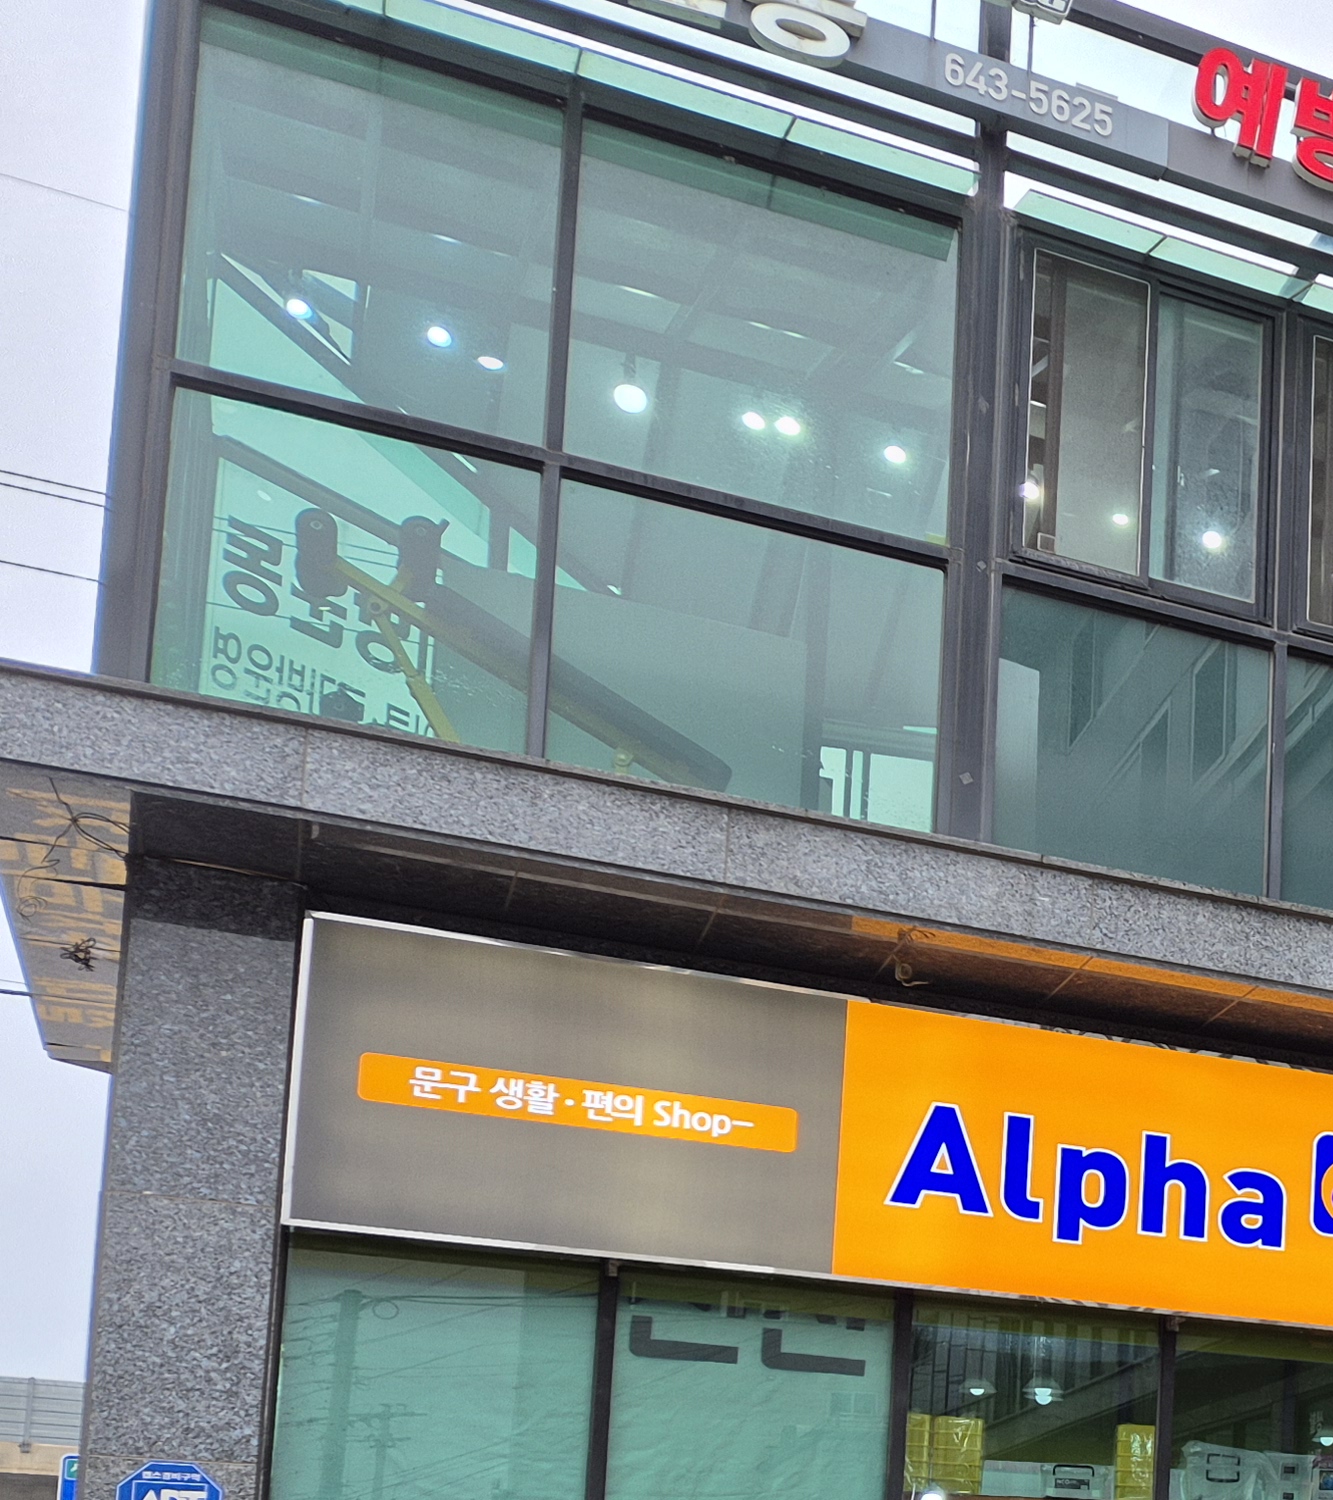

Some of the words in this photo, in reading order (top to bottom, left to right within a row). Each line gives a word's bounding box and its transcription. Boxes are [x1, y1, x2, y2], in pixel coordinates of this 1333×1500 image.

[944, 52, 1115, 137] 643-5625
[409, 1065, 482, 1105] 문구
[883, 1100, 1286, 1252] Alpha
